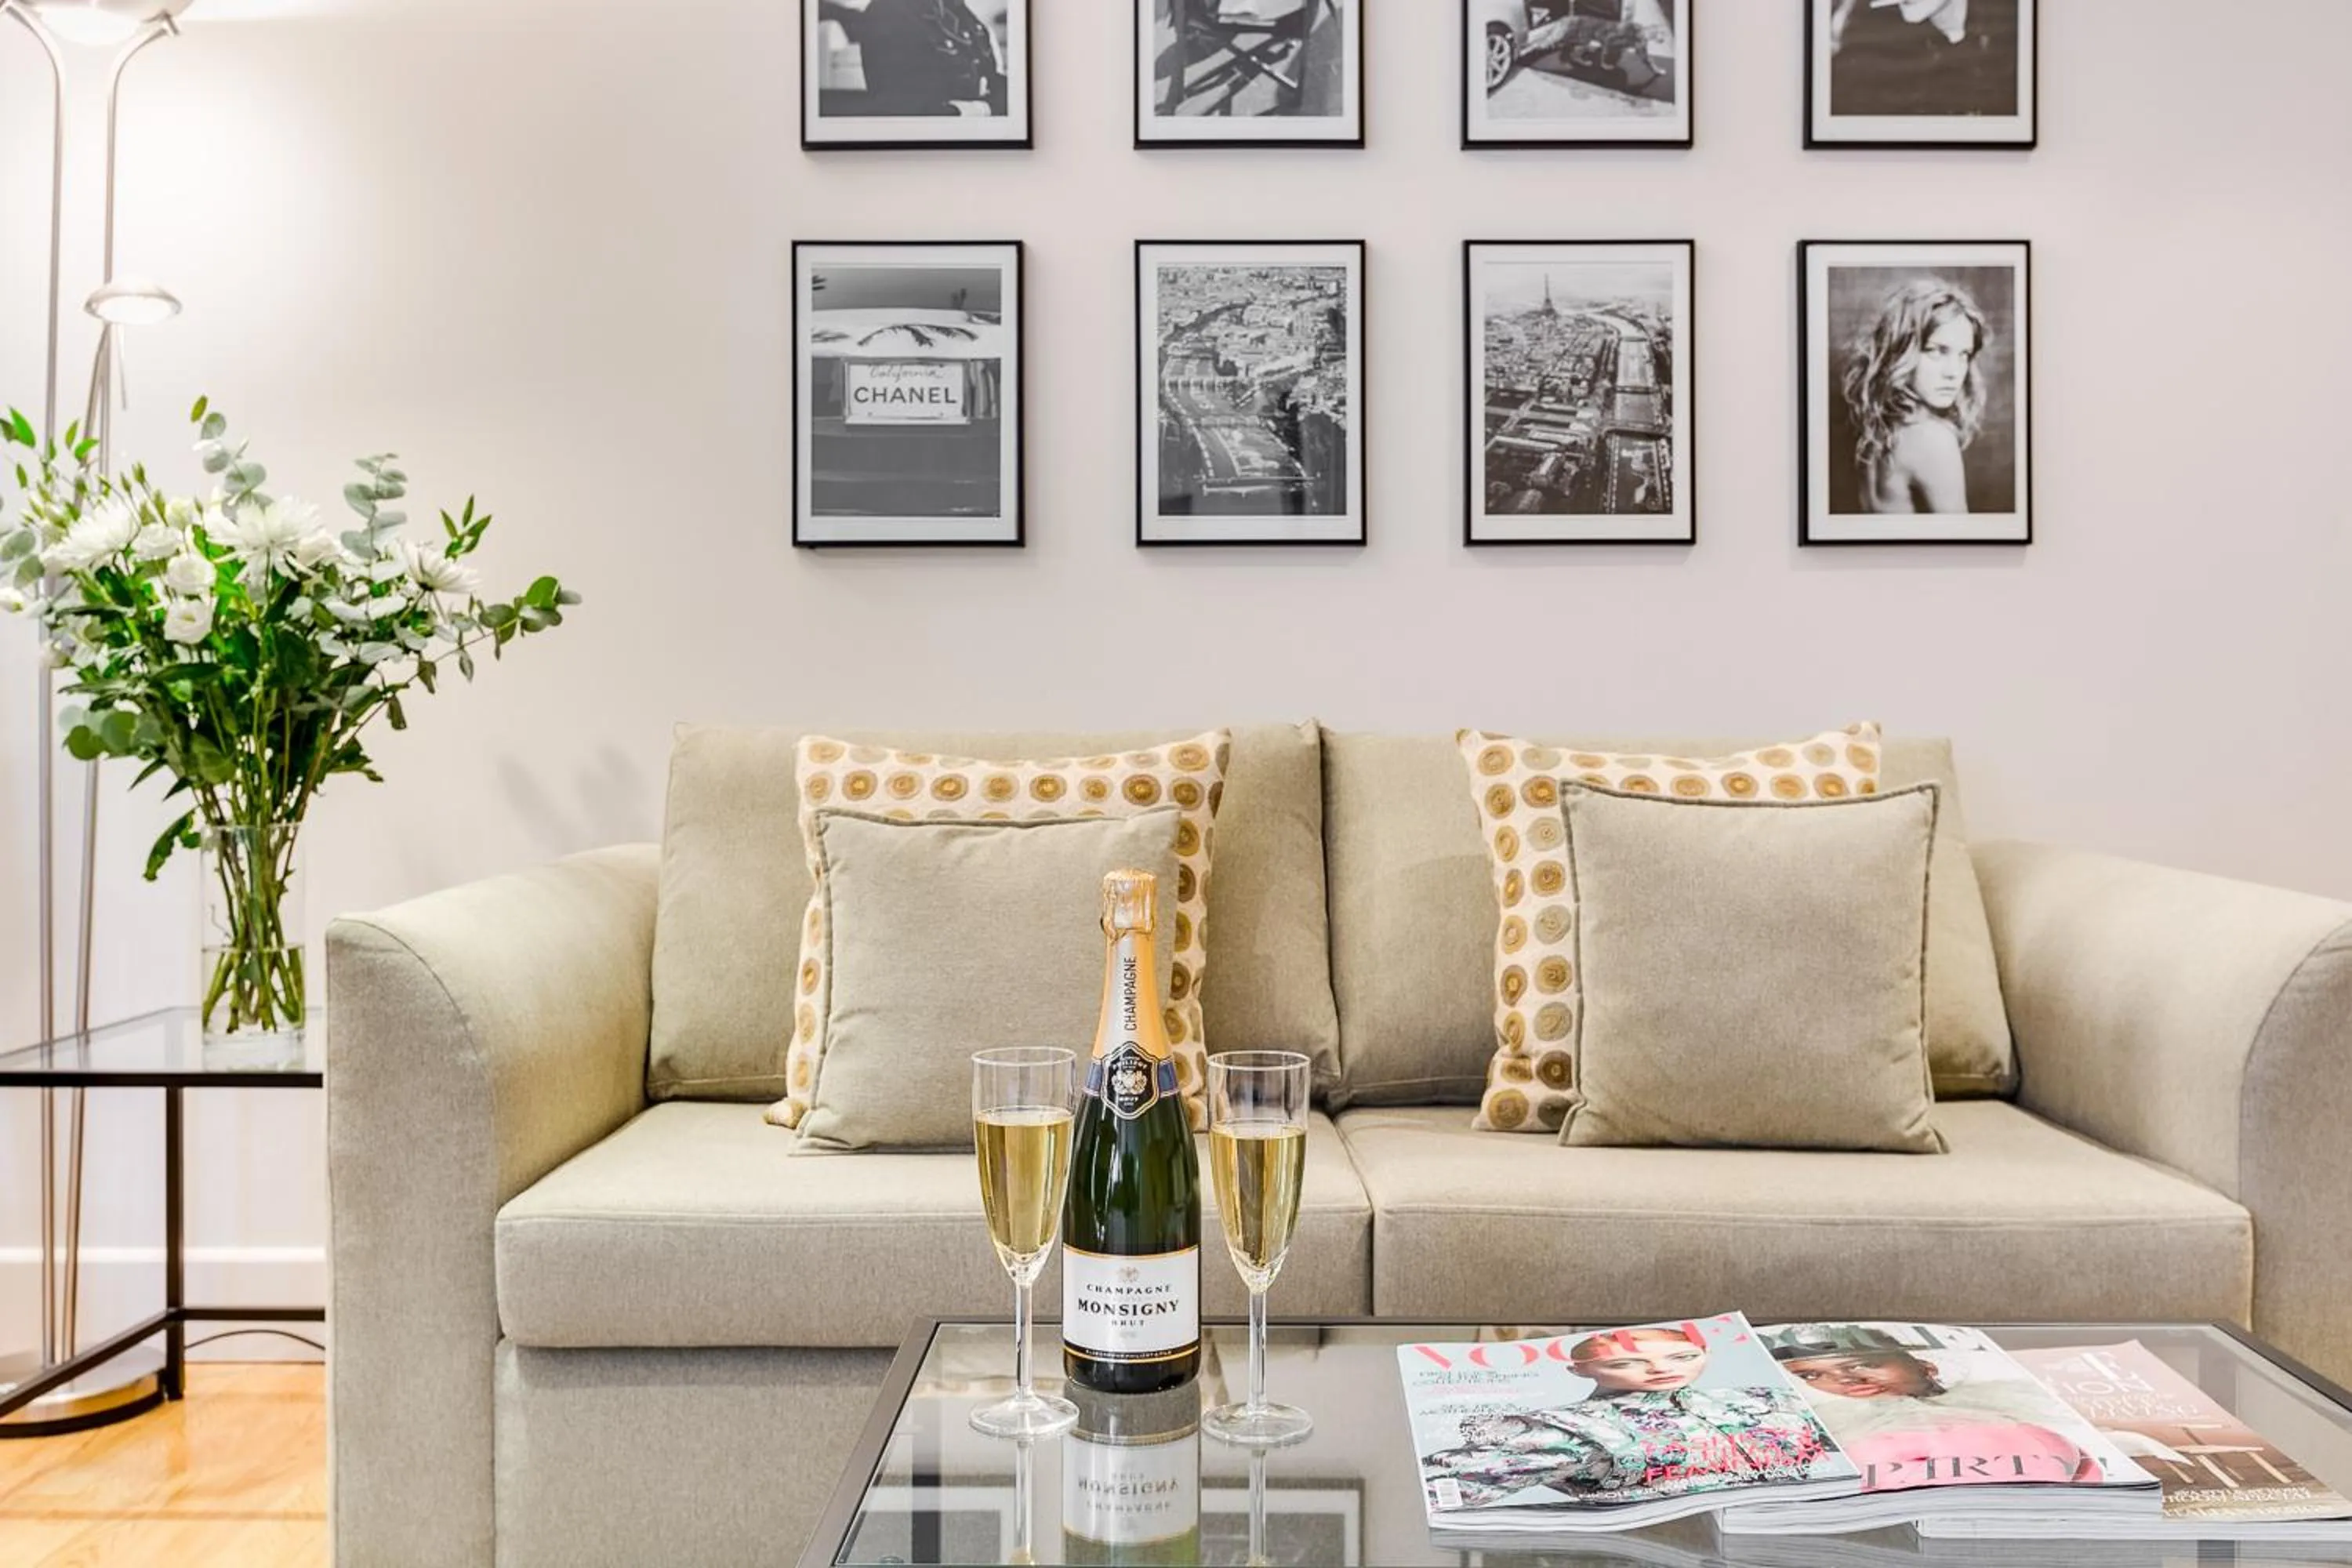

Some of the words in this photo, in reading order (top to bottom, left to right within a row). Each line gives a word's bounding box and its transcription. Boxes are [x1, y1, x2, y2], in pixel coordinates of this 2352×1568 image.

[854, 387, 957, 404] CHANEL
[1123, 956, 1138, 1032] CHAMPAGNE
[1086, 1283, 1173, 1295] CHAMPAGNE
[1077, 1298, 1180, 1316] MONSIGNY
[1111, 1319, 1145, 1327] BRUT
